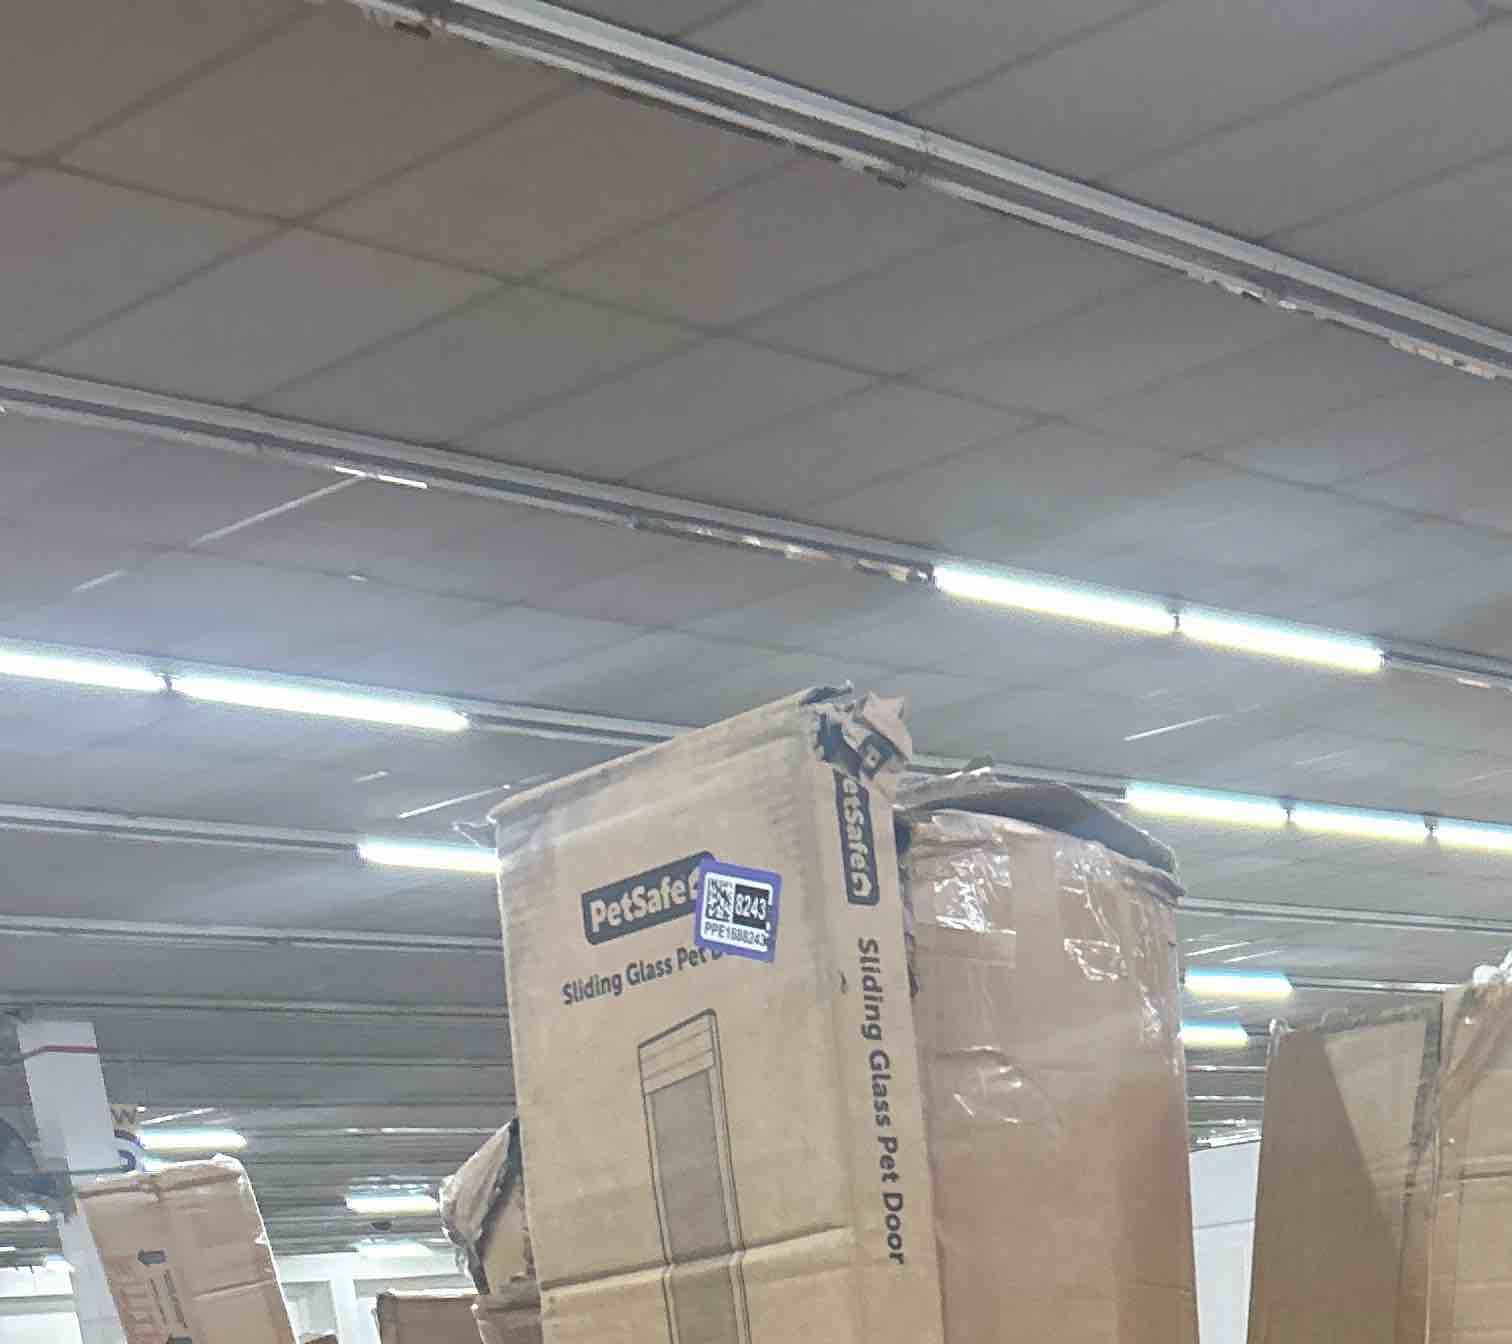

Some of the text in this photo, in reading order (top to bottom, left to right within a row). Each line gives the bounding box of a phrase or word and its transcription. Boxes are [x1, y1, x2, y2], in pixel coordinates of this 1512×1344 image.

[588, 875, 688, 933] PetSafe
[734, 893, 767, 920] 8243
[561, 974, 623, 1007] Sliding
[625, 957, 673, 985] Glass
[676, 946, 707, 970] Pet
[857, 937, 905, 1265] Sliding Glass Pet Door
